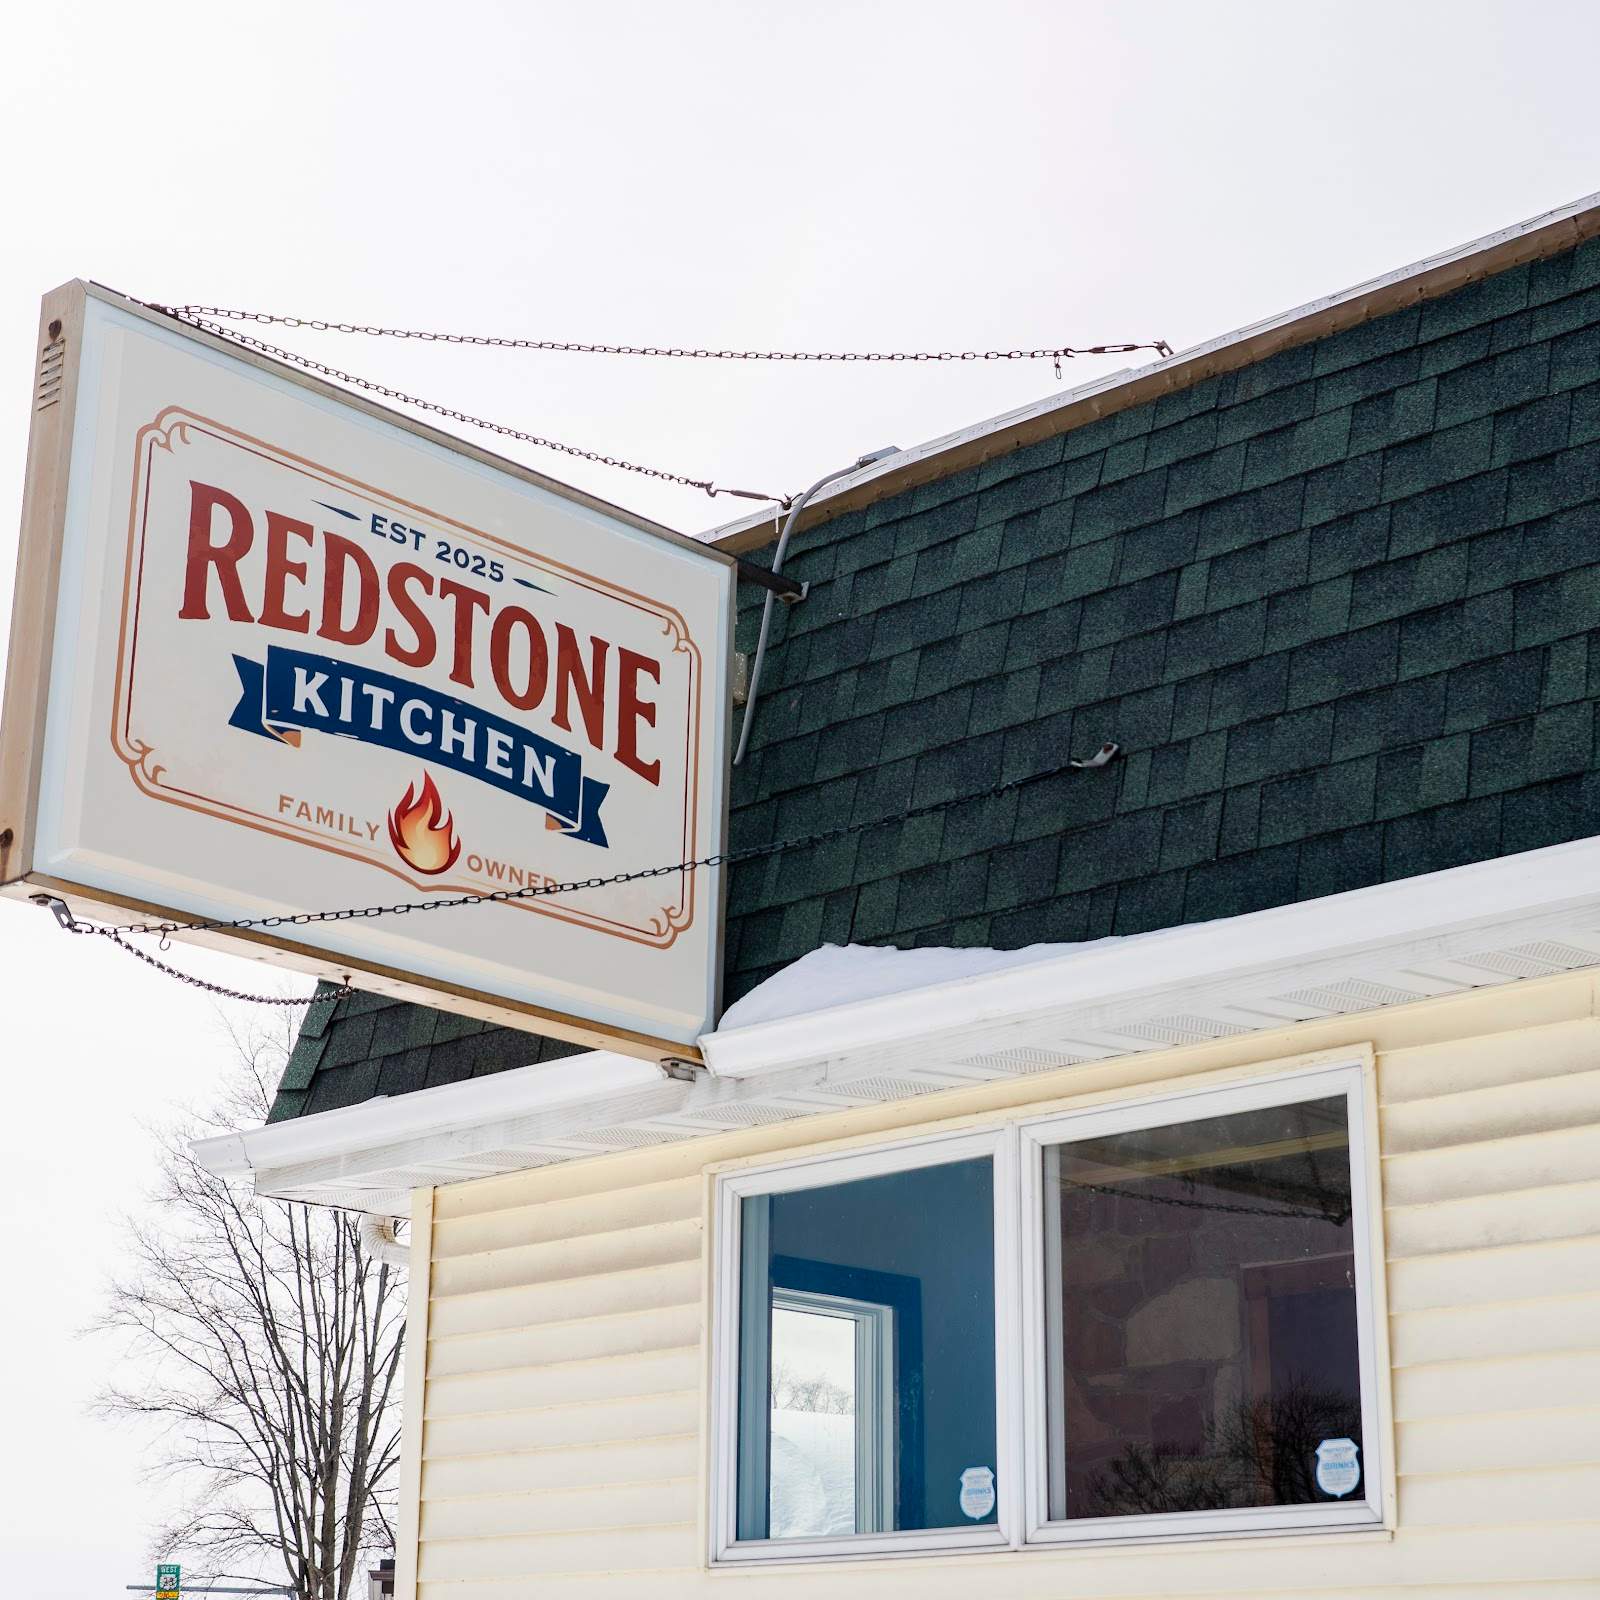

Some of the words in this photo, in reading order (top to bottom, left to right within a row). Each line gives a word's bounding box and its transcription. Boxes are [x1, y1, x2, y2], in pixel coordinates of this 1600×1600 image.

[370, 513, 426, 551] EST
[435, 541, 504, 583] 2025
[179, 480, 661, 786] REDSTONE
[291, 666, 558, 799] KITCHEN
[279, 794, 380, 840] FAMILY
[161, 1566, 177, 1574] WEST
